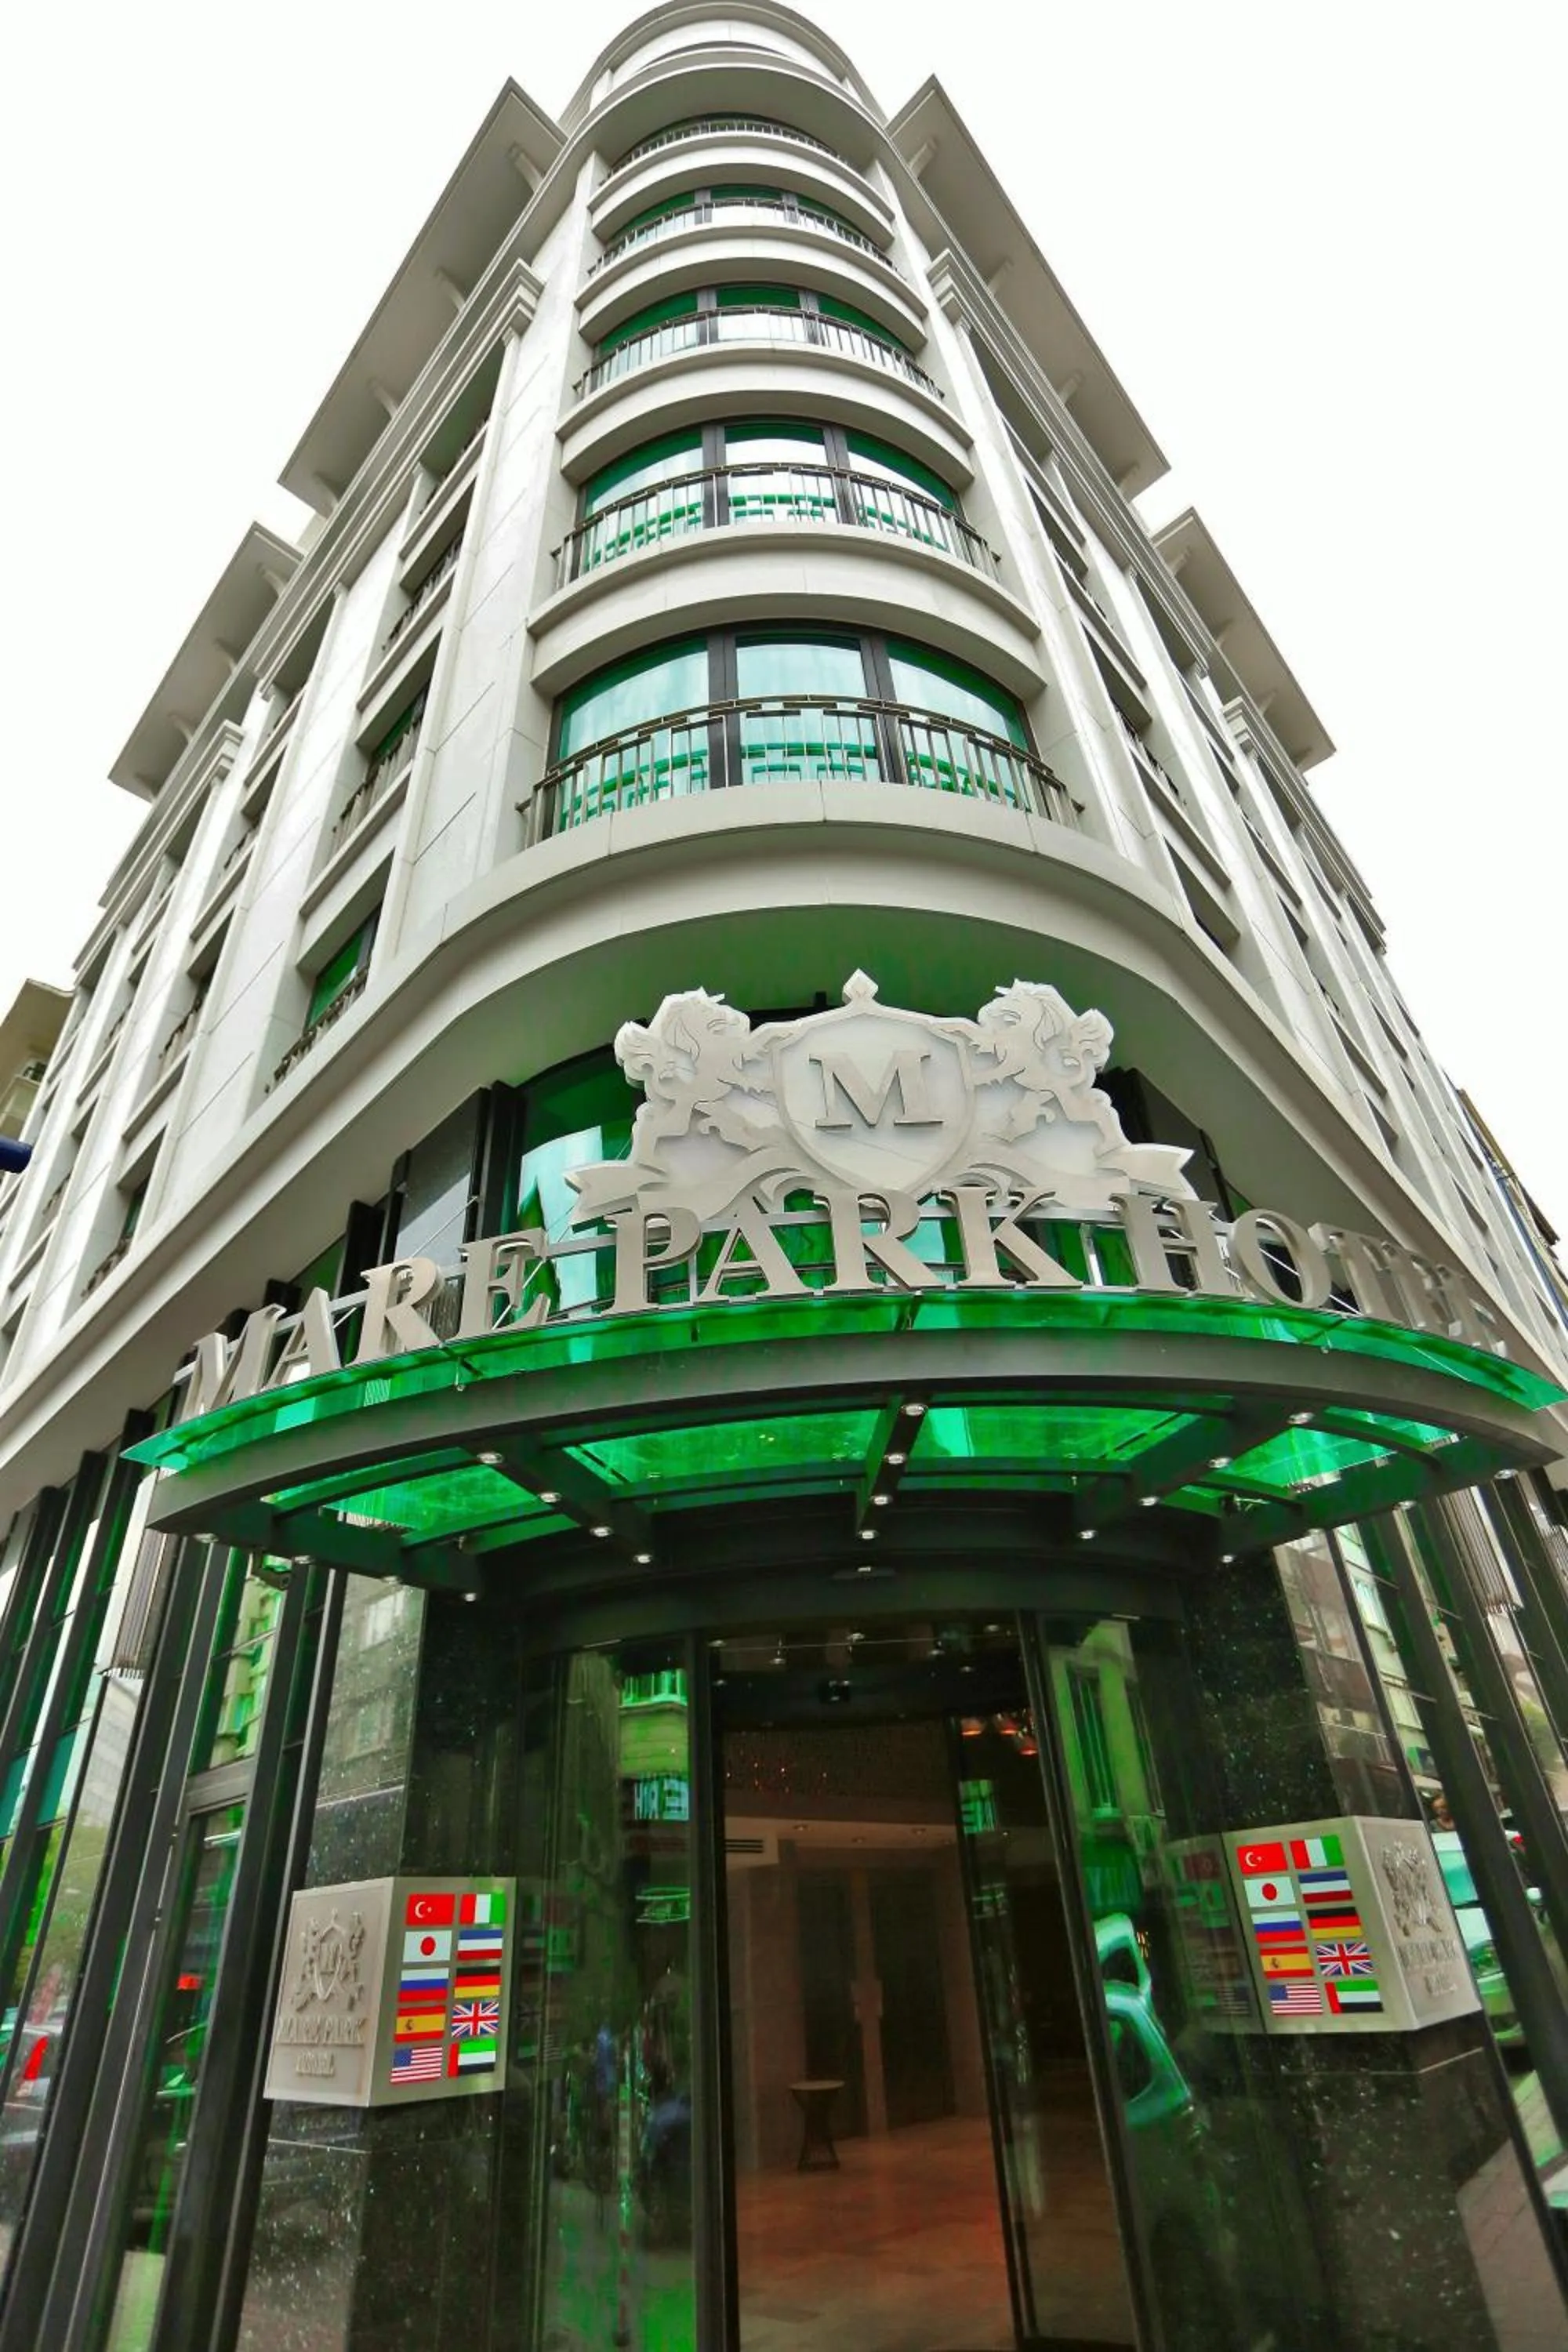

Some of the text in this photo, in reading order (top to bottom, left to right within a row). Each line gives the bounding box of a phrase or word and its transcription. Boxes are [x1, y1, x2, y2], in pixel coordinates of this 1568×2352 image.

[808, 1050, 945, 1131] M
[180, 1227, 551, 1424] MARE
[599, 1186, 1084, 1316] PARK
